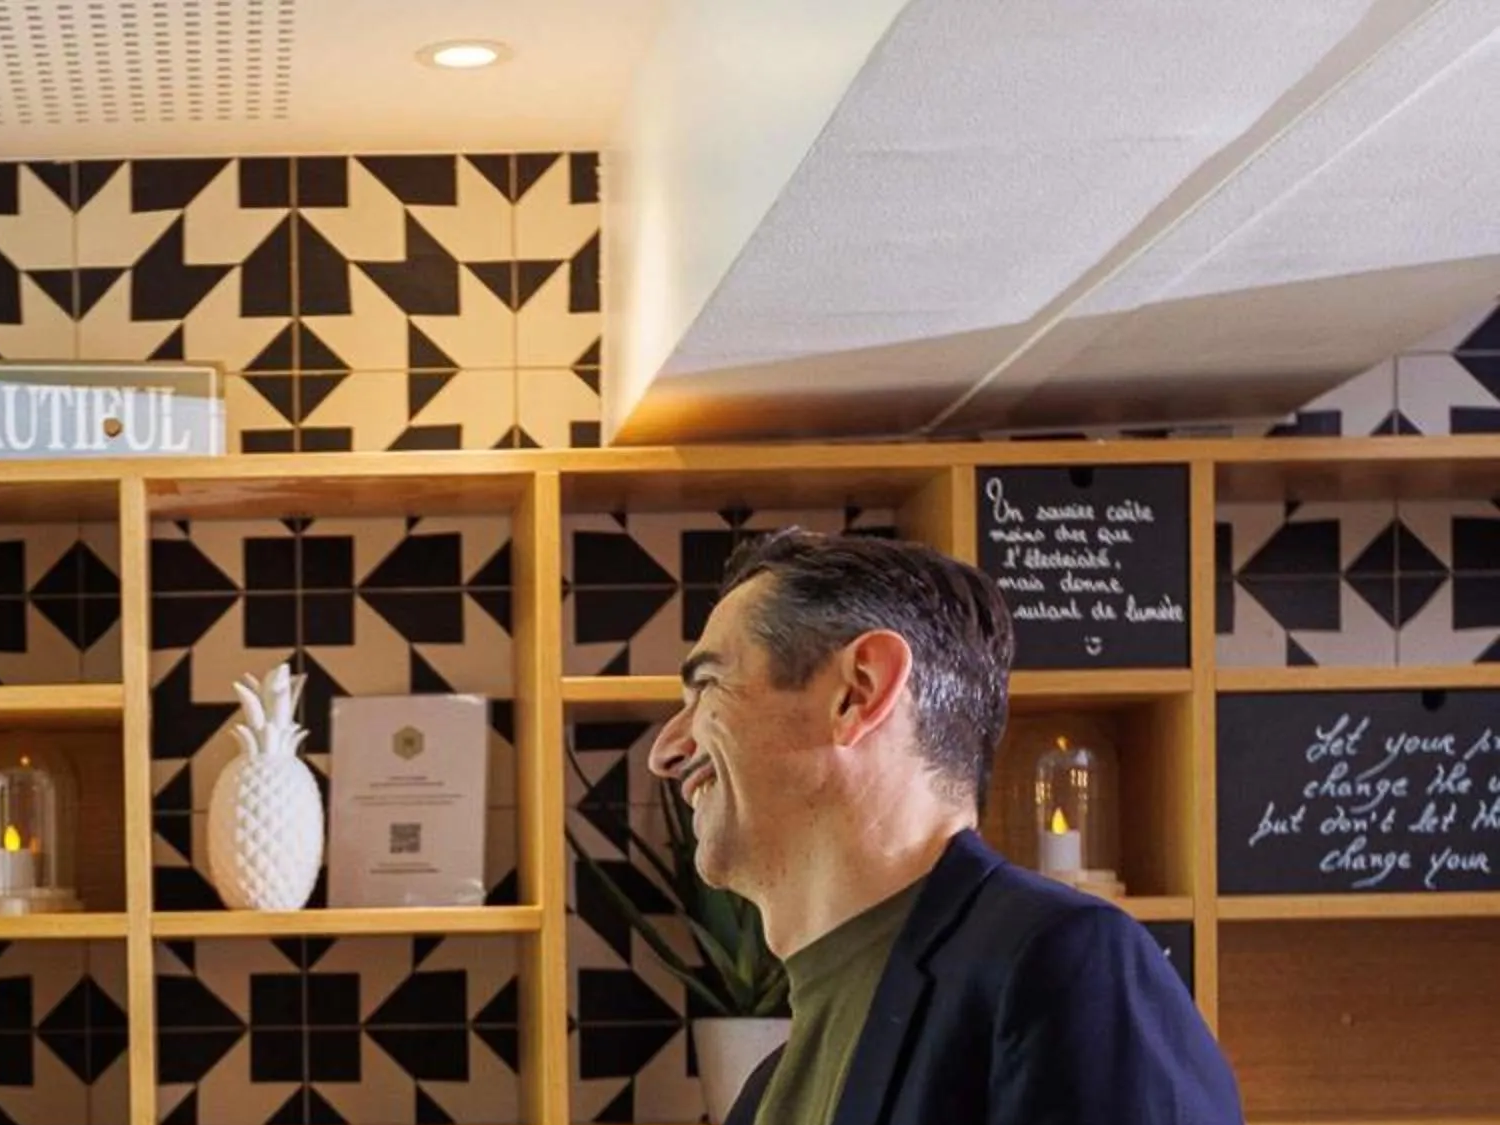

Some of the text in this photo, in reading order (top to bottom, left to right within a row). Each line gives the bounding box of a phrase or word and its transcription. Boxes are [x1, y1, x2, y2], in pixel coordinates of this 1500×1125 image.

[997, 570, 1124, 594] mais donne
[1013, 598, 1082, 620] autant
[1091, 601, 1116, 621] de
[1305, 713, 1370, 763] Let
[1355, 733, 1456, 781] your
[1303, 761, 1408, 814] change
[1426, 761, 1472, 795] the
[1248, 801, 1307, 847] but
[1408, 801, 1457, 833] let
[1319, 835, 1491, 890] change your
